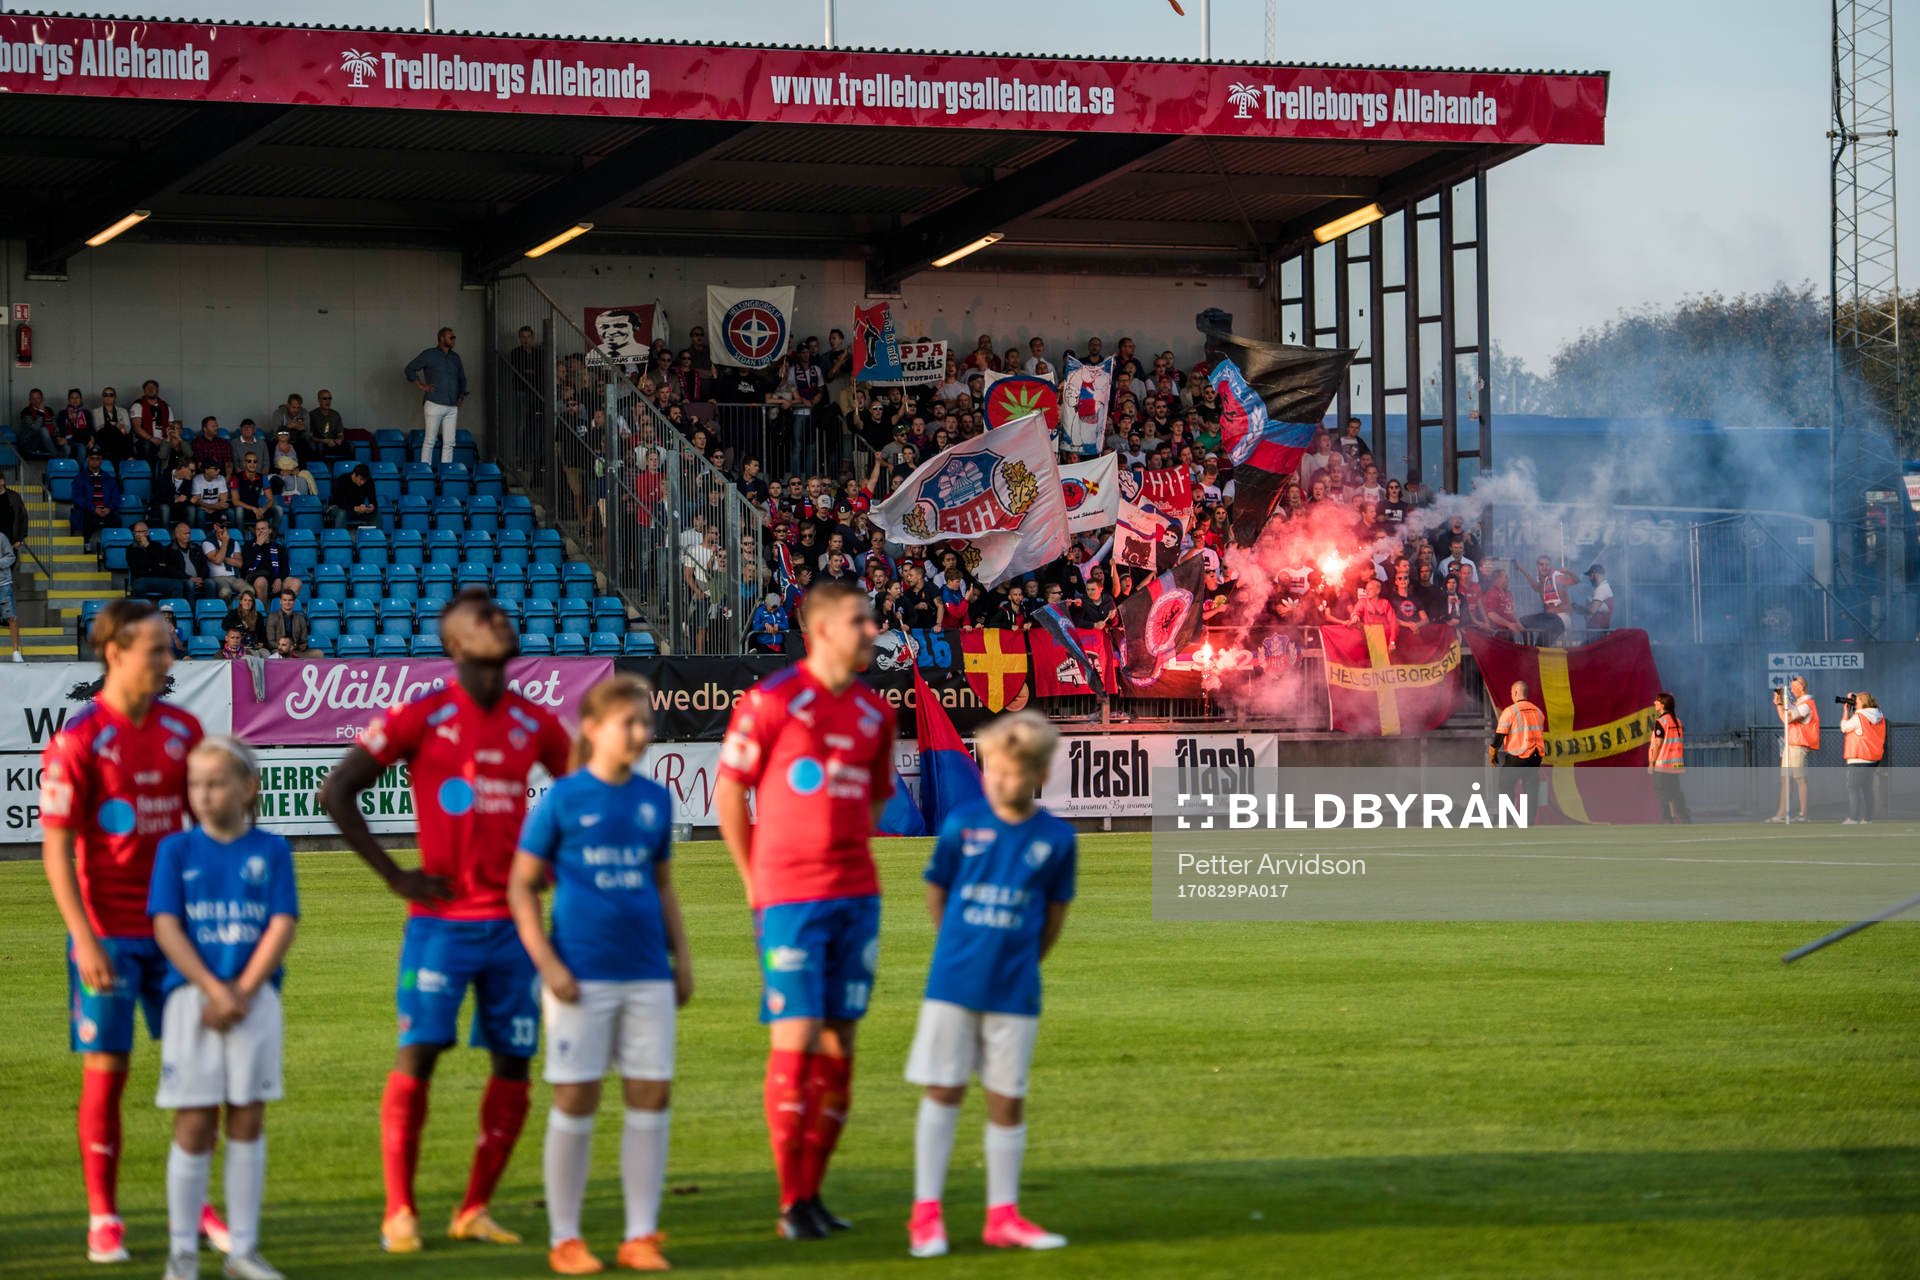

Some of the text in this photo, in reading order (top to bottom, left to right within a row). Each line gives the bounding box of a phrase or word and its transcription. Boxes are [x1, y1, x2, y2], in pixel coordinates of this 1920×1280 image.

[80, 38, 209, 81] Allehanda
[381, 52, 650, 99] Trelleborgs Allehanda
[770, 72, 1115, 115] www.trelleborgsallehanda.se
[1263, 85, 1497, 127] Trelleborgs Allehanda
[1787, 655, 1858, 667] TOALETTER
[1069, 739, 1149, 798] flash
[1175, 738, 1255, 796] flash
